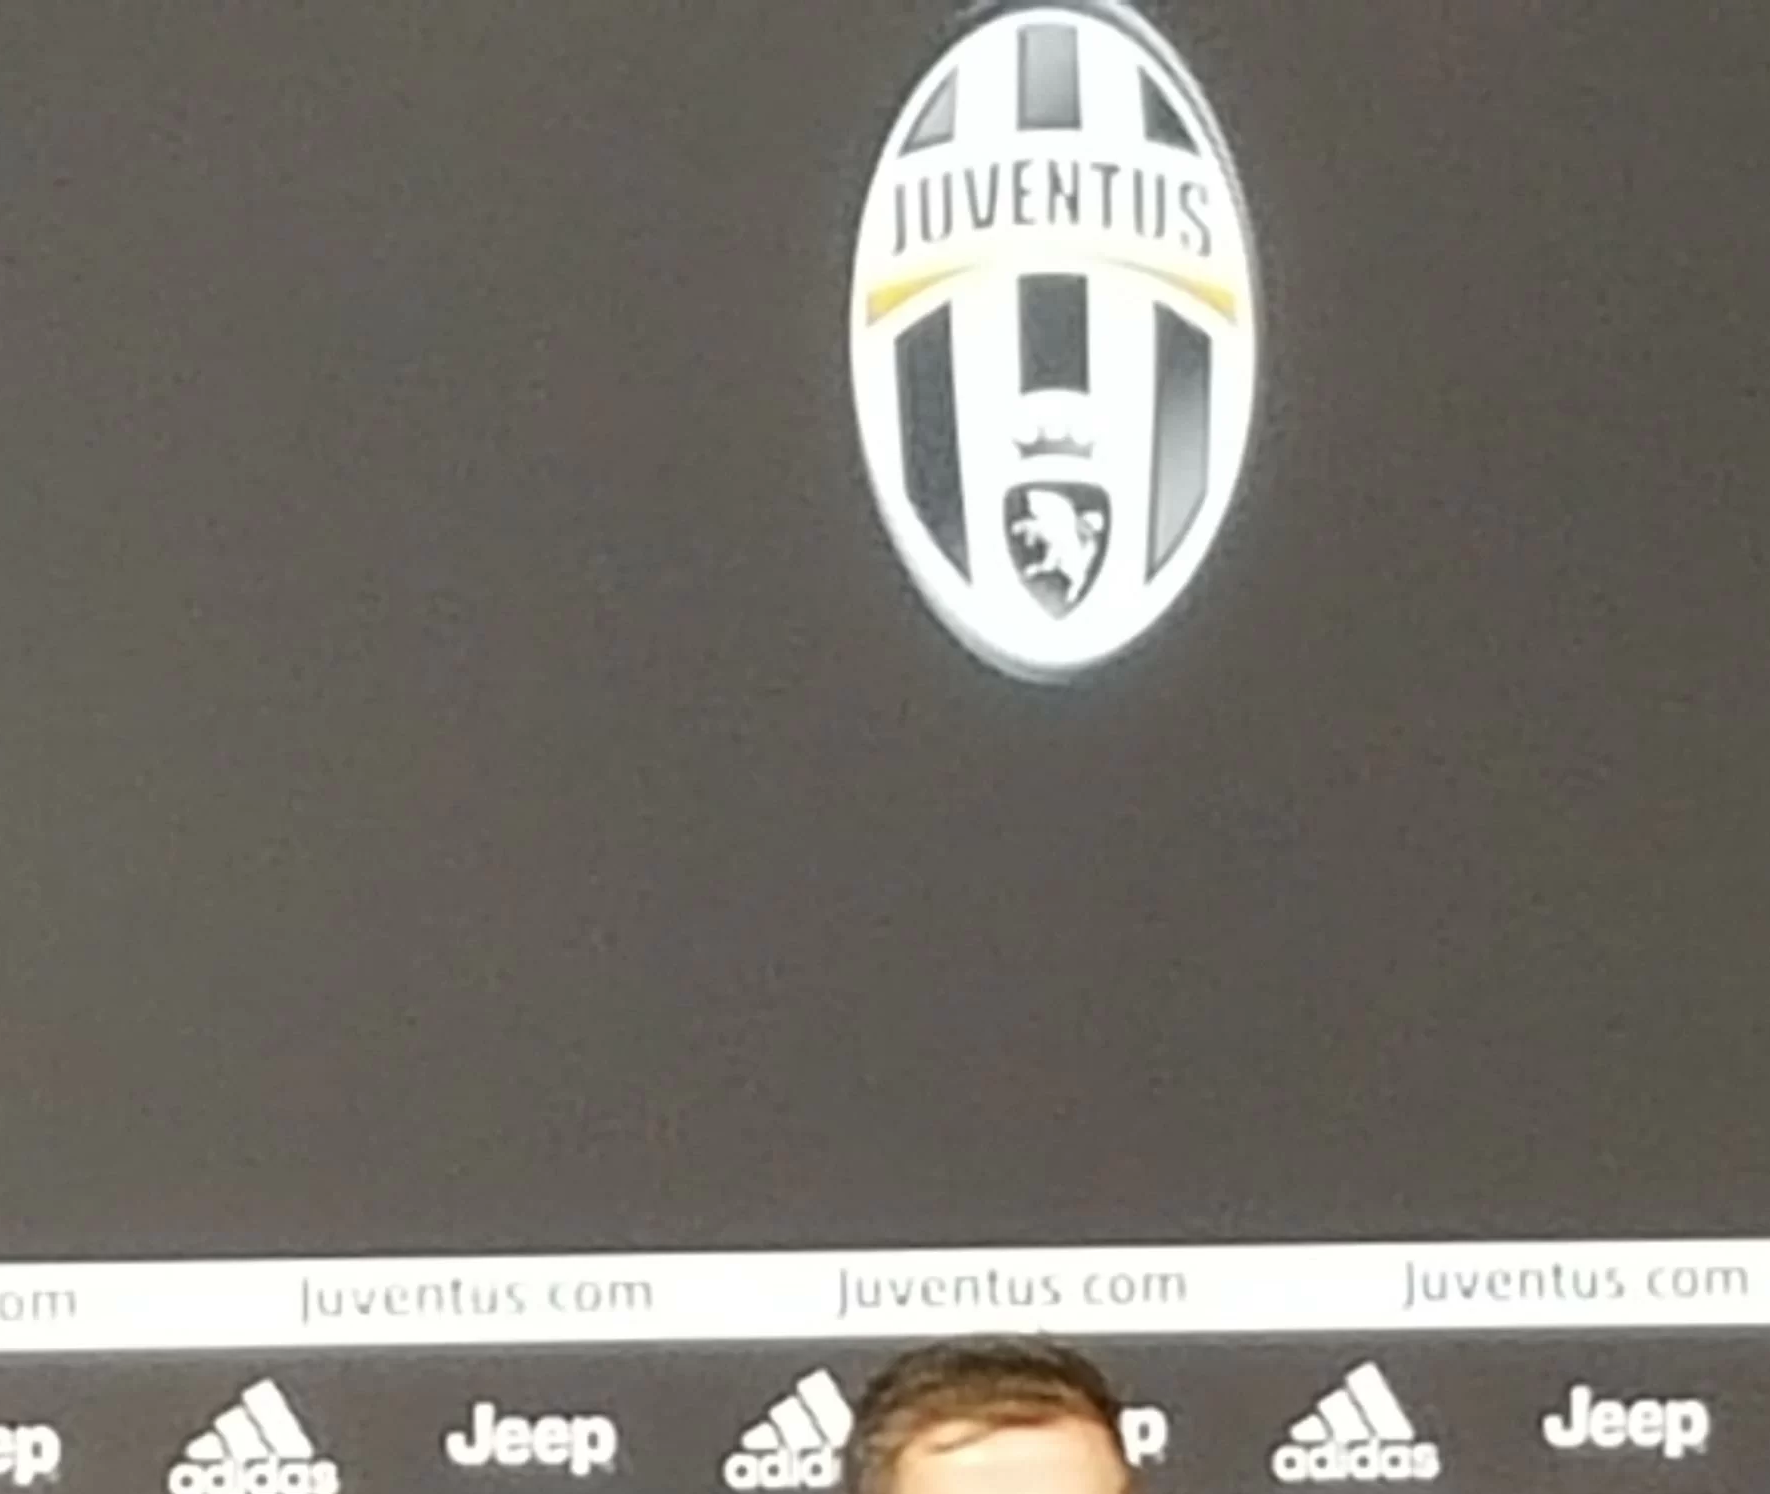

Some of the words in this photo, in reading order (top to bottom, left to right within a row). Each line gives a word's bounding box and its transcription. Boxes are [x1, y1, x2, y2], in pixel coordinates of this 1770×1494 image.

[893, 158, 1212, 257] JUVENTUS
[300, 1276, 654, 1327] Juventuscom
[836, 1268, 1187, 1321] Juventuscom
[1401, 1260, 1750, 1311] Juventuscom
[445, 1404, 619, 1475] Jeep
[1542, 1387, 1710, 1458] Jeep
[723, 1449, 842, 1491] adid
[1272, 1439, 1440, 1482] adidas
